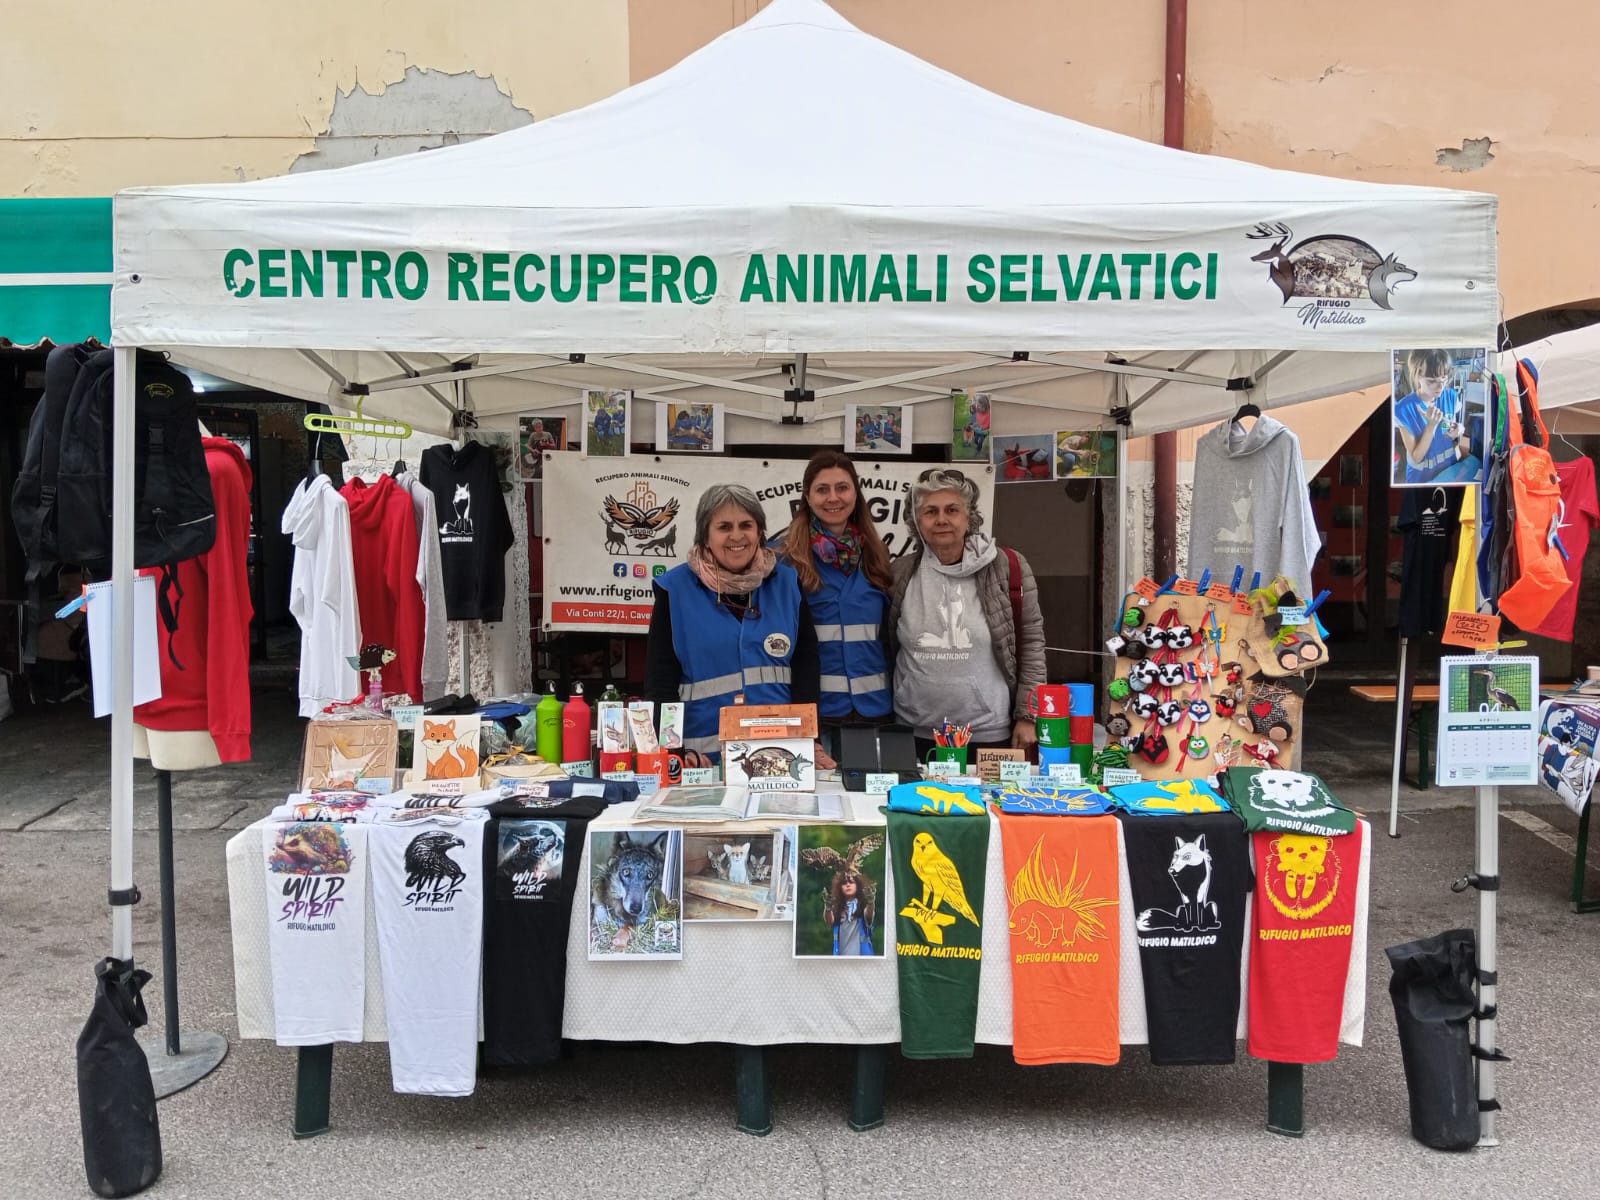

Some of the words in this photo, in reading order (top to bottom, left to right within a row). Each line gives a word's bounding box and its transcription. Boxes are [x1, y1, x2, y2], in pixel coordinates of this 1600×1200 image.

[223, 248, 429, 301] CENTRO
[448, 252, 718, 304] RECUPERO
[740, 253, 948, 303] ANIMALI
[966, 251, 1219, 303] SELVATICI
[1316, 299, 1351, 308] RIFUGIO
[1297, 303, 1367, 330] Matildico
[595, 472, 629, 484] RECUPERO
[660, 474, 690, 488] SELVATICI
[756, 481, 803, 502] ECUPE
[859, 477, 898, 491] MALI
[566, 608, 580, 618] Via
[582, 608, 605, 618] Conti
[630, 610, 653, 620] Cave
[937, 652, 969, 660] MATILDICO
[1479, 702, 1501, 715] 04
[747, 781, 799, 790] MATILDICO
[1266, 816, 1302, 831] RIFUGIO
[405, 870, 467, 895] WILD
[512, 868, 548, 886] WILD
[282, 870, 345, 906] WILD
[511, 883, 547, 895] SPIRIT
[401, 889, 463, 907] SPIRIT
[277, 897, 345, 924] SPIRIT
[307, 922, 336, 932] MATILDICO
[1259, 929, 1299, 941] RIFUGIO
[1300, 924, 1352, 940] MATILDICO
[1137, 935, 1170, 948] RIFUGIO
[1170, 935, 1217, 947] MATILDICO
[896, 942, 930, 957] RIFUGIO
[930, 946, 982, 961] MATILDICO
[1015, 952, 1050, 965] RIFUGIO
[1051, 952, 1099, 963] MATILDICO
